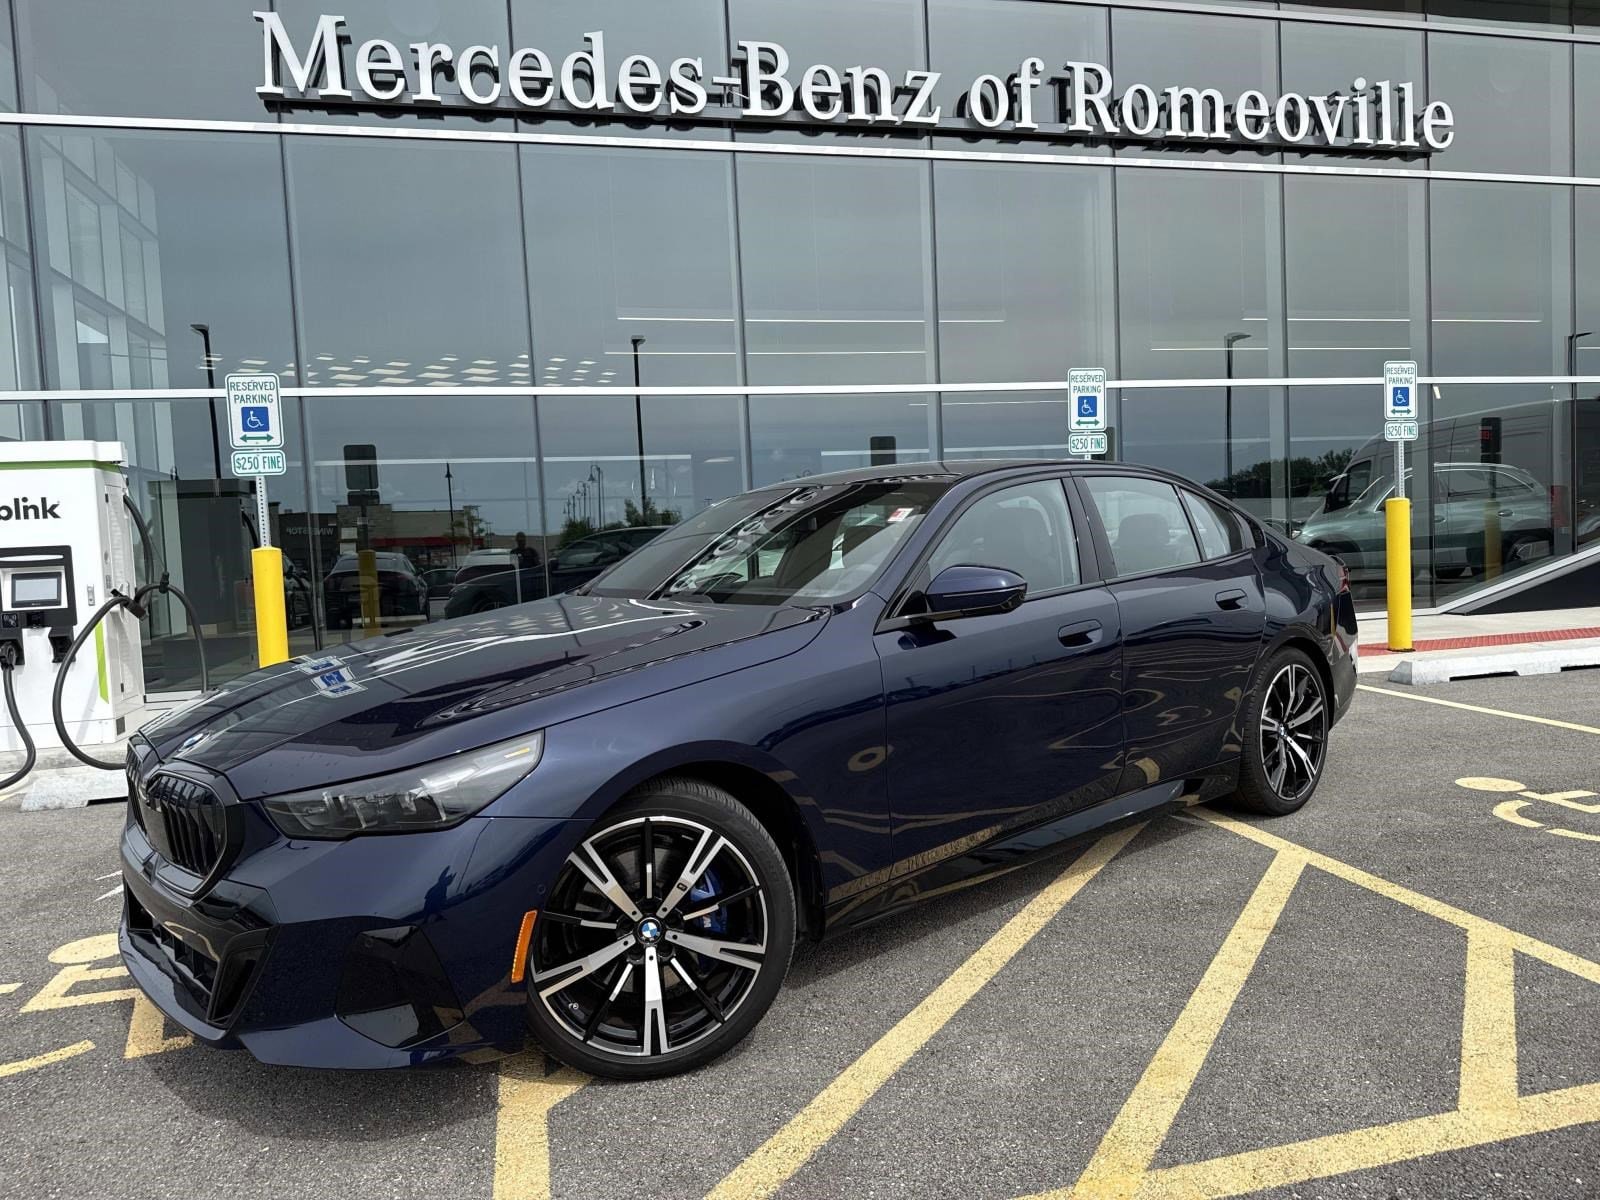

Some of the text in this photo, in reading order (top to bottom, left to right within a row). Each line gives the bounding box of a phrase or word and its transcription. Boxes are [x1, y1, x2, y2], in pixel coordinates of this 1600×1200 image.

[253, 10, 1455, 150] Mercedes-Benz of Romeoville
[1386, 366, 1415, 375] RESERVED
[1070, 374, 1103, 383] RESERVED
[1388, 376, 1413, 384] PARKING
[229, 381, 275, 391] RESERVED
[1073, 385, 1102, 394] PARKING
[233, 394, 274, 404] PARKING
[1387, 425, 1416, 436] $250 FINE
[1071, 437, 1104, 449] $250 FINE
[235, 455, 282, 471] $250 FINE
